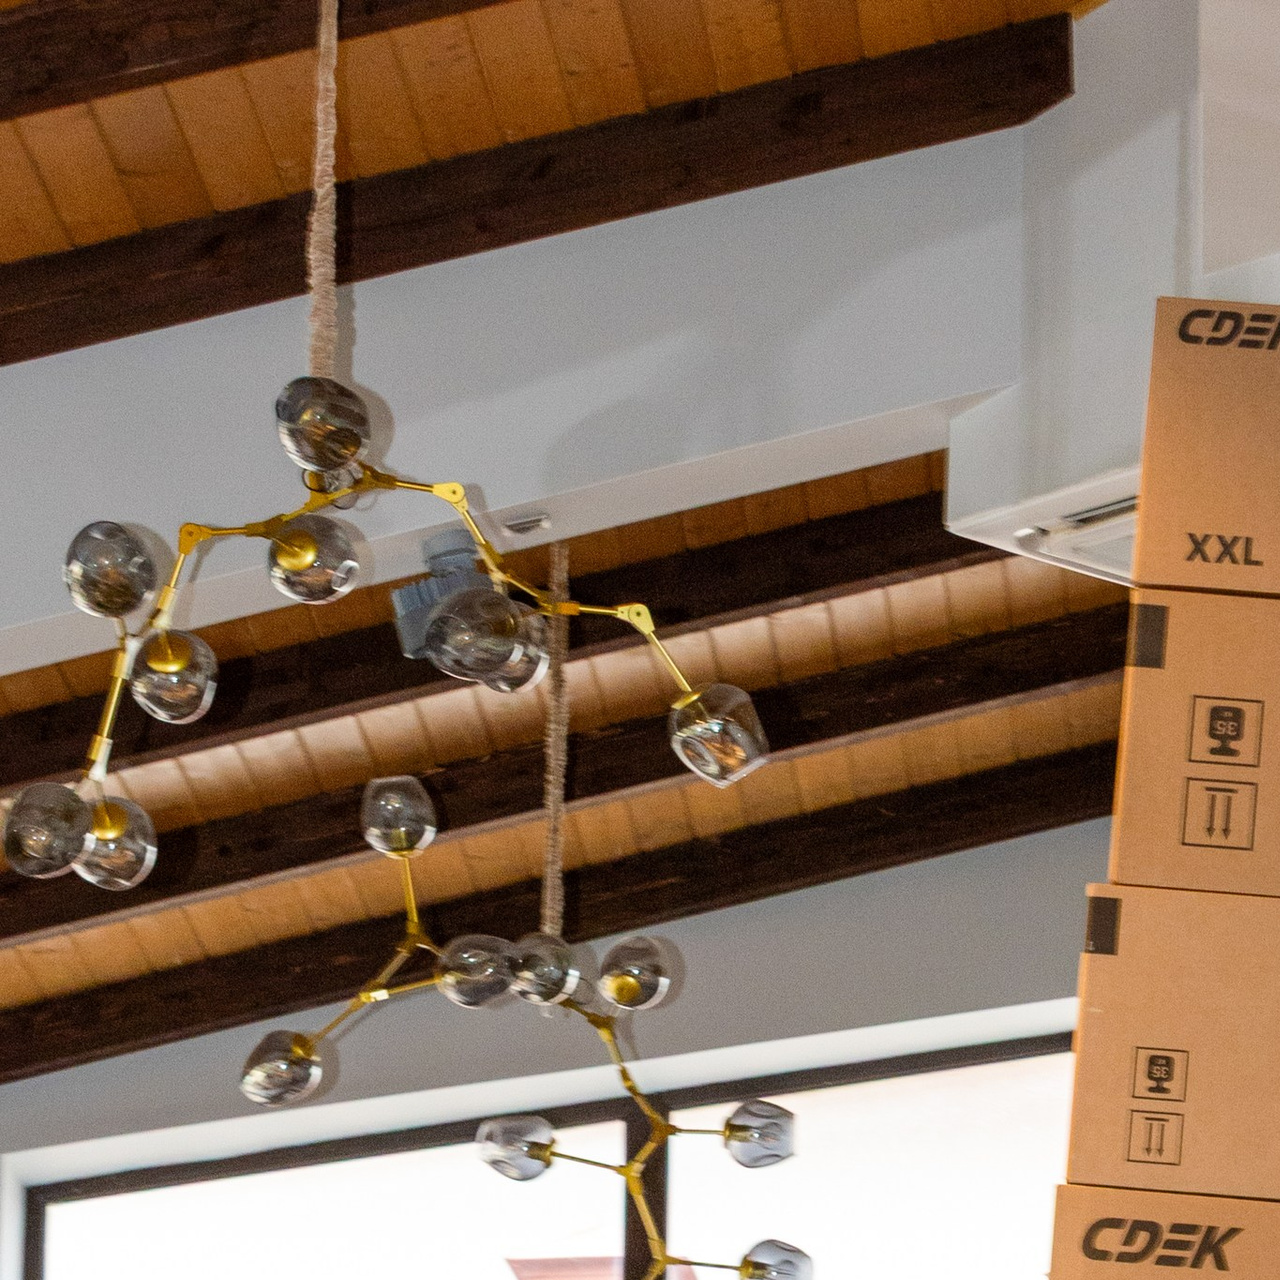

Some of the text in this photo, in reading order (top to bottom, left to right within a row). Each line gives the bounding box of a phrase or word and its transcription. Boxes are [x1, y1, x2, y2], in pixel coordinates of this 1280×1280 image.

[1186, 533, 1263, 566] XXL
[1216, 720, 1237, 735] 35
[1152, 1066, 1169, 1078] 35
[1082, 1218, 1244, 1271] CDEK
